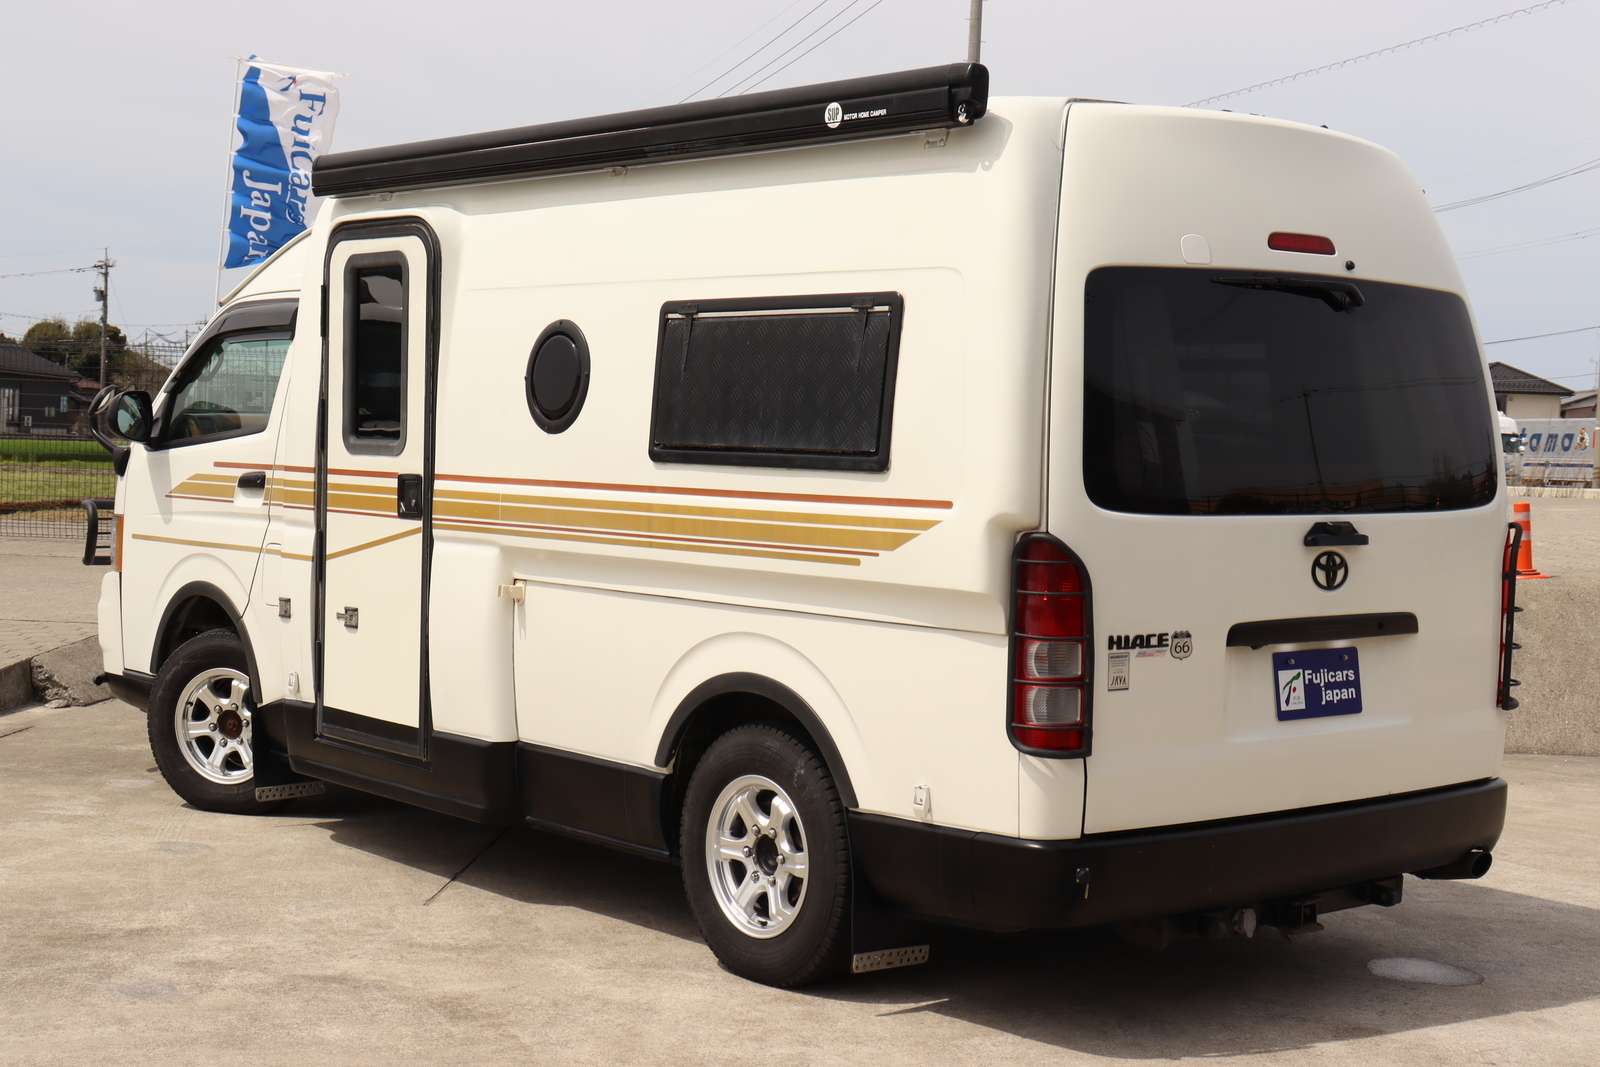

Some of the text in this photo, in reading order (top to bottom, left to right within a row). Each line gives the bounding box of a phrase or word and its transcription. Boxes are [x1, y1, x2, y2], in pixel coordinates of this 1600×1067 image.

[827, 107, 840, 121] SUP
[870, 109, 887, 117] CAMPER
[240, 169, 282, 263] Japan
[1108, 632, 1169, 650] HIACE
[1174, 641, 1190, 654] 66
[1111, 676, 1127, 686] JRVA
[1304, 668, 1355, 687] Fujicars
[1321, 687, 1356, 705] japan
